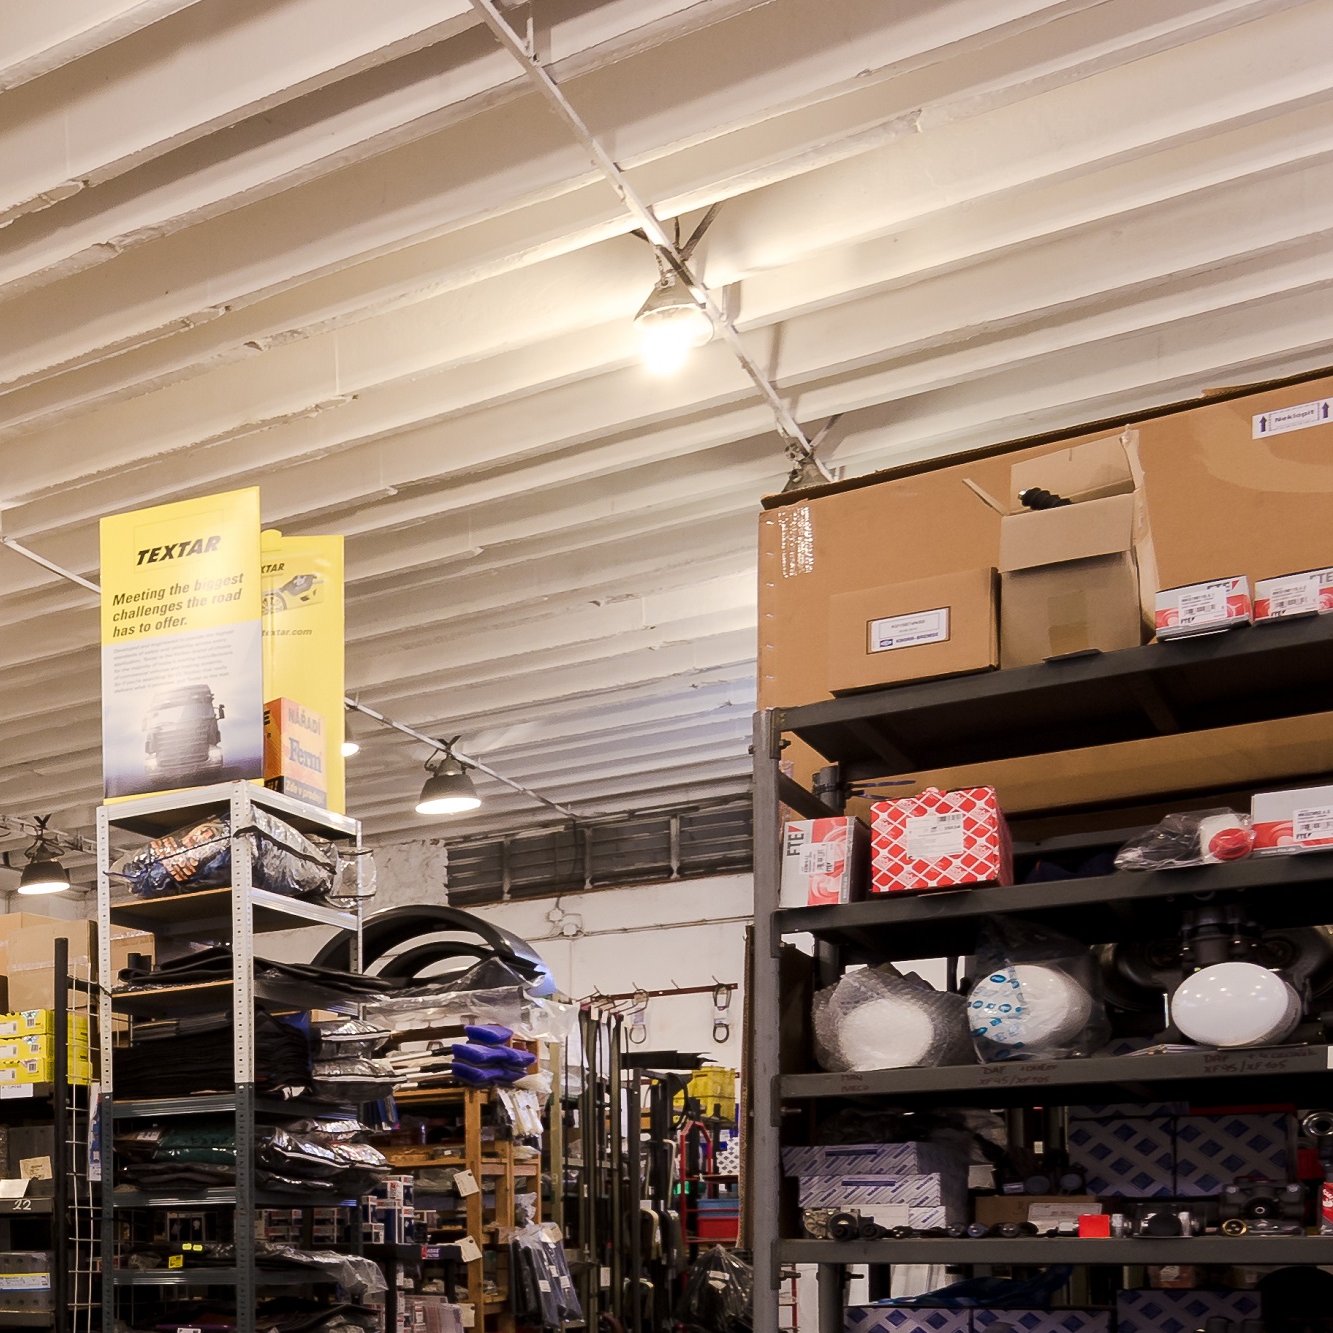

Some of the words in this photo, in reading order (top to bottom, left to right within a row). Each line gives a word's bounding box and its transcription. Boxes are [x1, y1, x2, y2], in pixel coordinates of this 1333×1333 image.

[136, 535, 221, 566] TEXTAR
[112, 588, 165, 607] Meeting
[169, 583, 190, 595] the
[193, 573, 244, 591] biggest
[112, 600, 183, 622] challenges
[187, 596, 208, 609] the
[212, 589, 242, 605] road
[112, 624, 135, 638] has
[138, 622, 151, 634] to
[155, 616, 188, 631] offer.
[13, 1199, 32, 1211] 22
